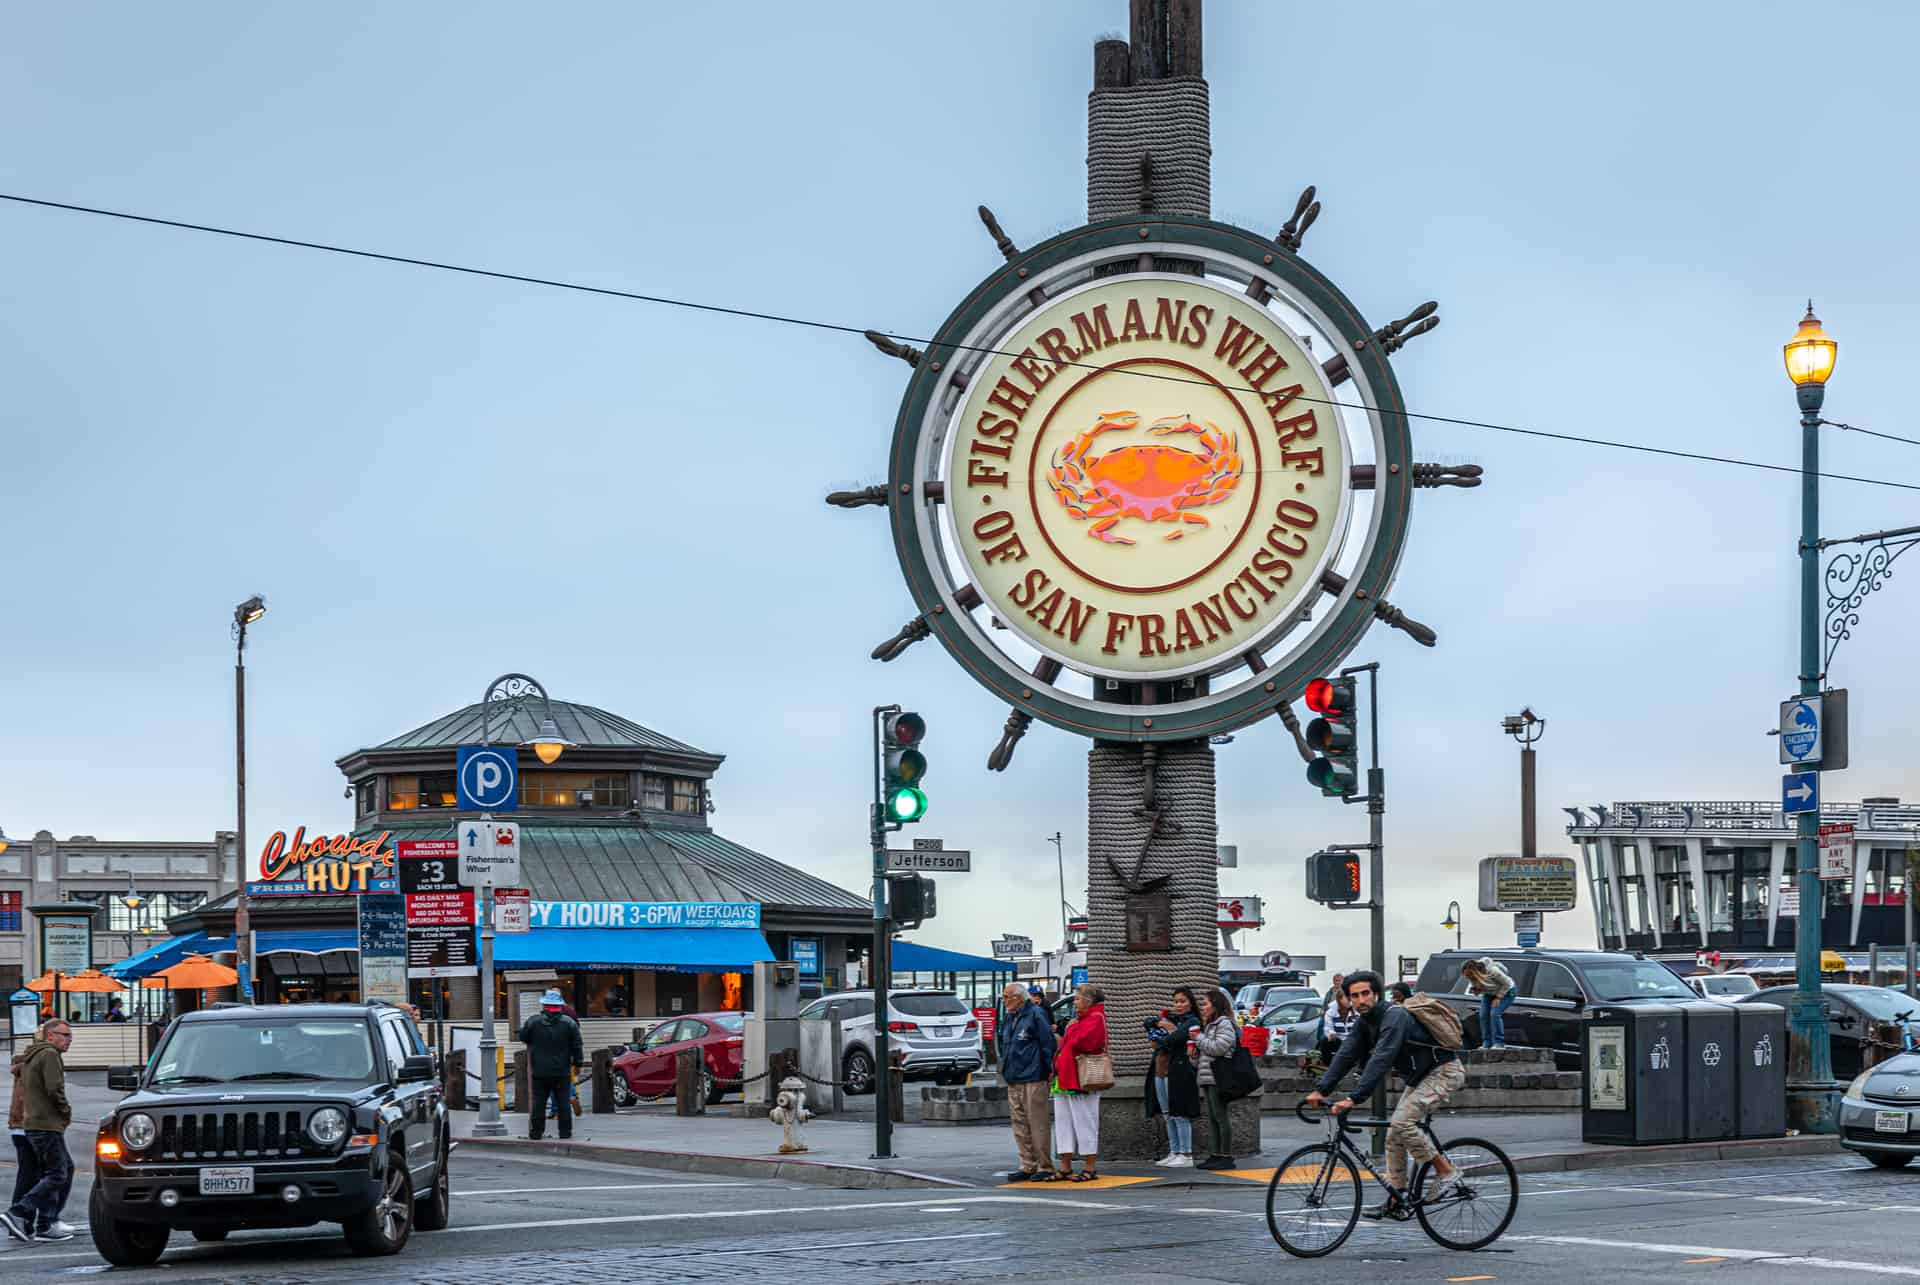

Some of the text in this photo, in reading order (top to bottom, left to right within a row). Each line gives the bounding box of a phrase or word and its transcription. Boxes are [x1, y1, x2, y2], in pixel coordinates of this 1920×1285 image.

[968, 298, 1324, 488] FISHERMANS WHARF
[973, 499, 1319, 657] OF SAN FRANCISCO
[260, 825, 395, 881] Chowde
[1828, 848, 1843, 857] ANY
[466, 855, 515, 864] Fisherman's
[894, 854, 964, 867] Jefferson
[1828, 858, 1844, 868] TIME
[422, 861, 445, 882] $3
[466, 865, 491, 873] Wharf
[306, 861, 373, 892] HUT
[251, 884, 305, 893] FRESH
[475, 902, 757, 926] HPY HOUR 3-6PM WEEKDAYS
[504, 908, 521, 916] ANY
[503, 916, 521, 924] TIME
[203, 1177, 251, 1192] 8HHX577
